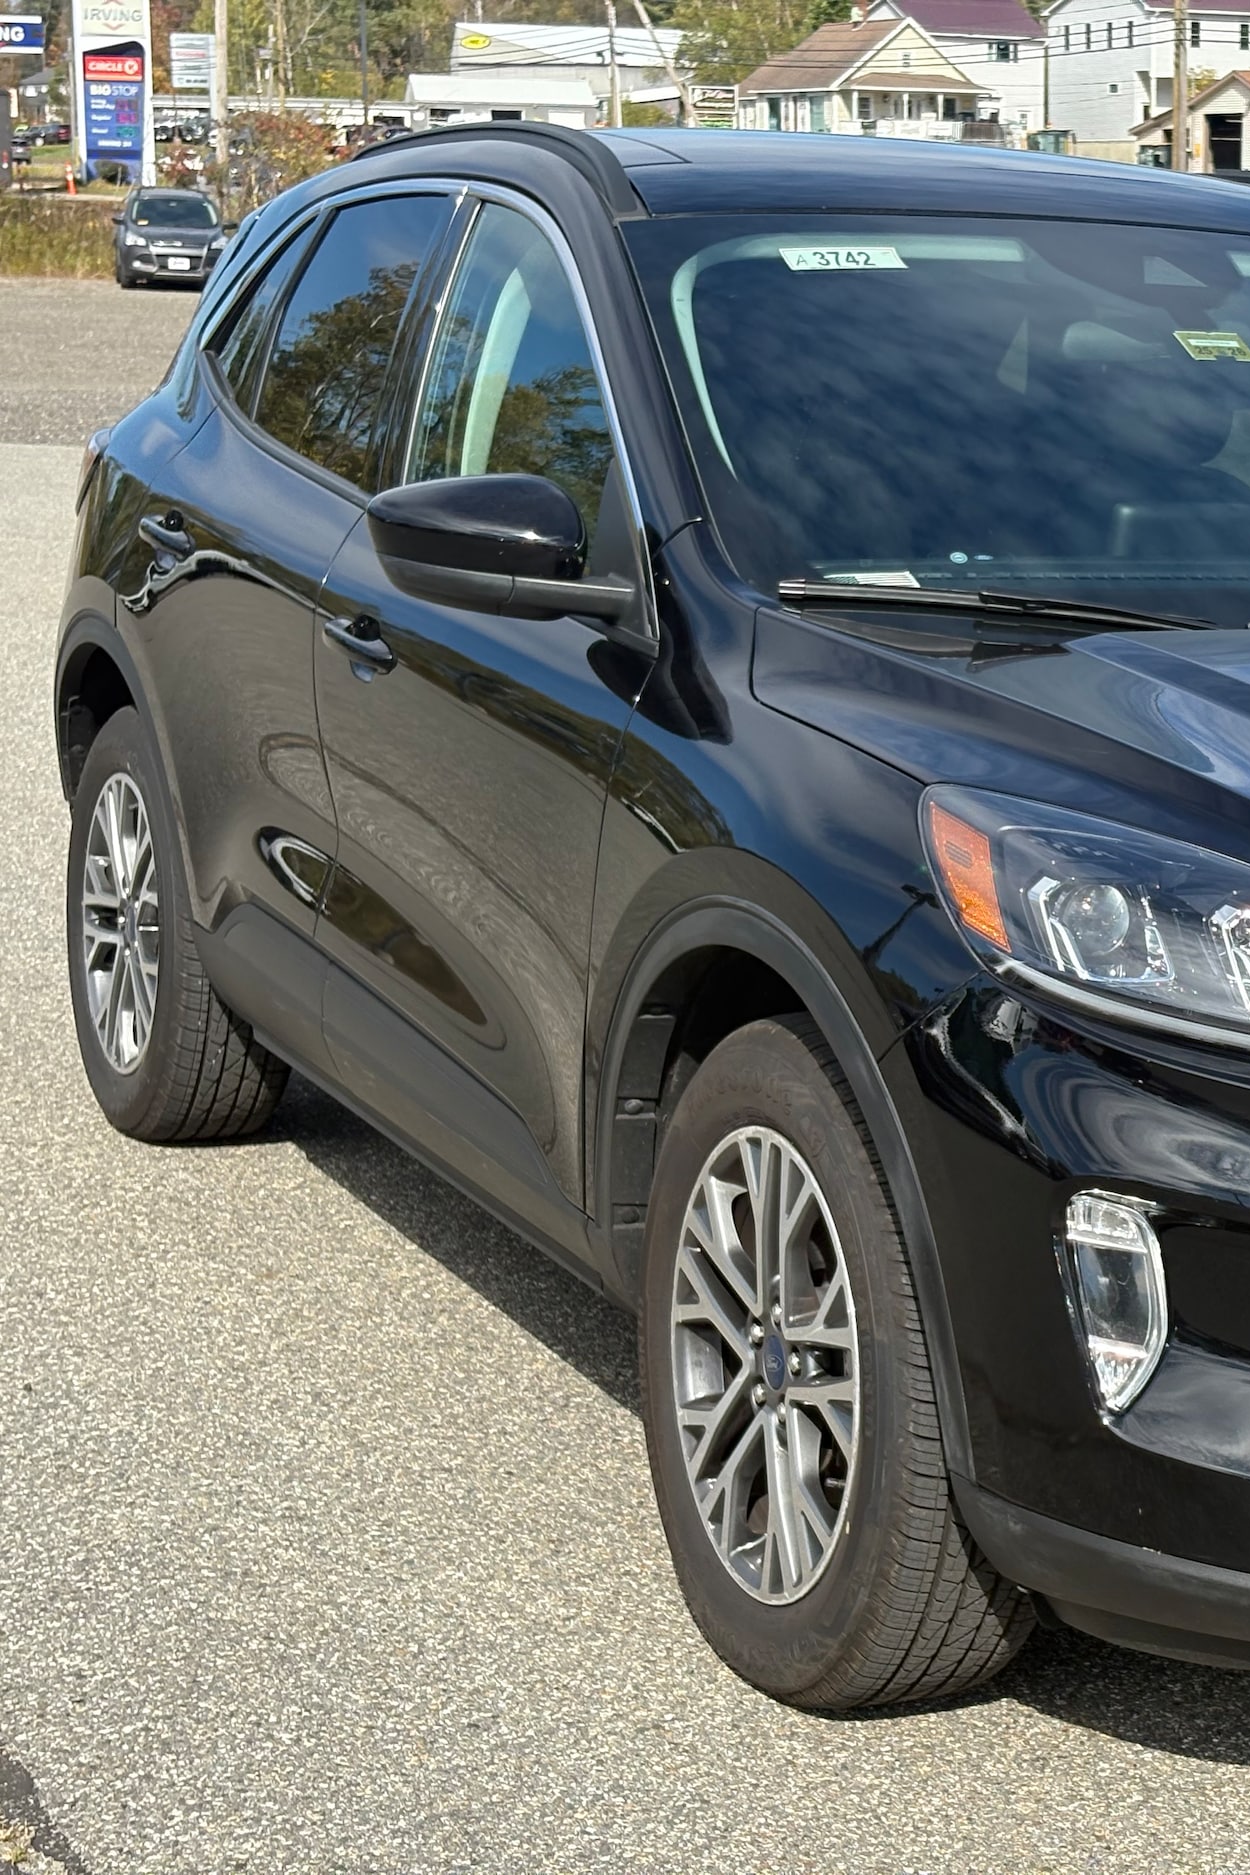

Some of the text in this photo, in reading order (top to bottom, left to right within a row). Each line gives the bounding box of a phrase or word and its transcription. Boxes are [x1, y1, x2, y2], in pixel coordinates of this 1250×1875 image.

[84, 7, 143, 22] IRVING
[88, 61, 123, 72] CIRCLE
[90, 84, 139, 97] BIG STOP
[796, 251, 877, 267] A 3742
